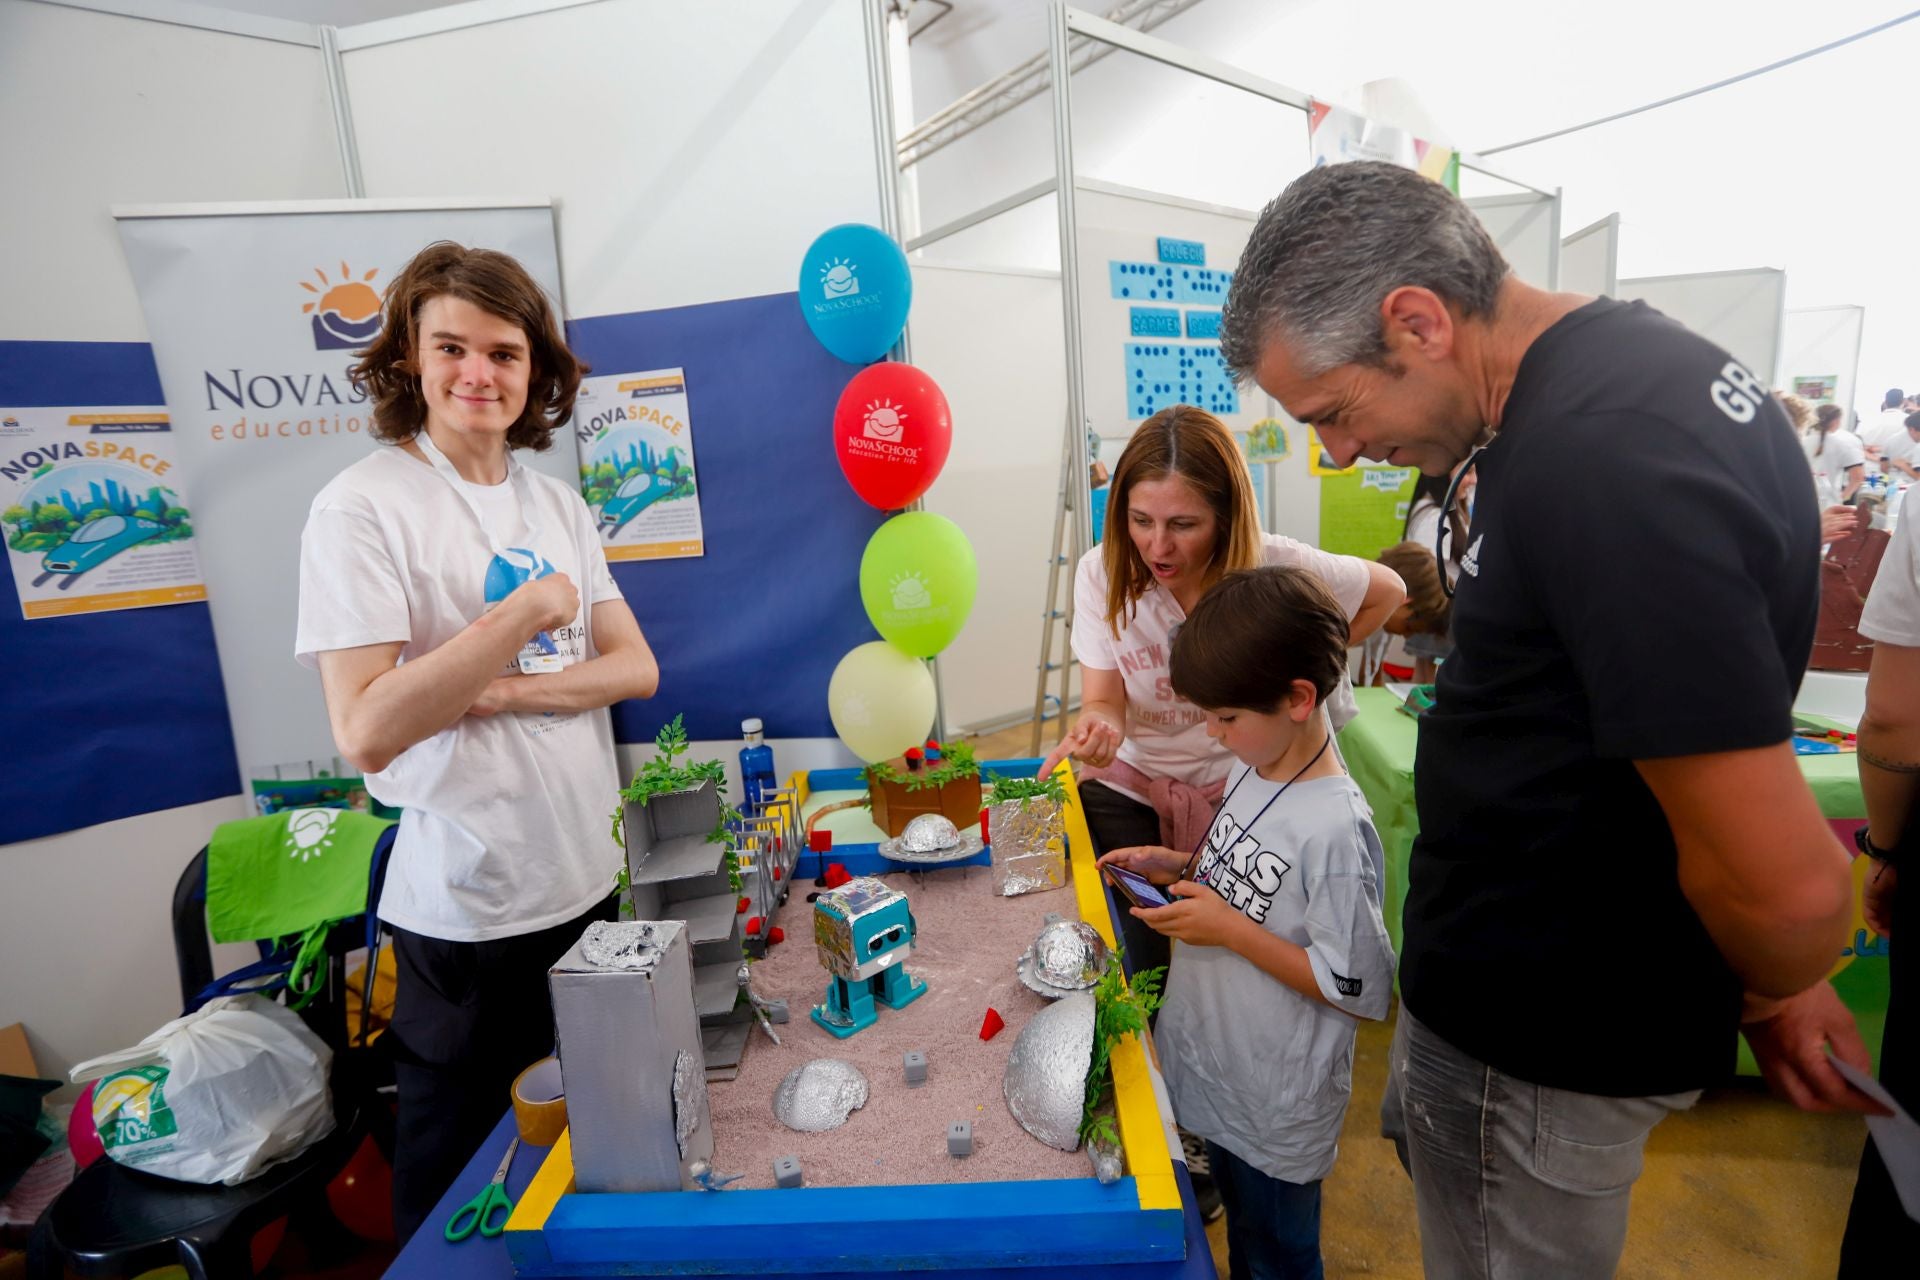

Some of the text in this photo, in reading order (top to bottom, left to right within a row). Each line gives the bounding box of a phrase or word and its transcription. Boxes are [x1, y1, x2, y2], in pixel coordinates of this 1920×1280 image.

[577, 405, 683, 443] NOVASPACE
[1120, 644, 1165, 676] NEW
[1136, 706, 1177, 725] LOWER
[1208, 813, 1292, 898] SKS
